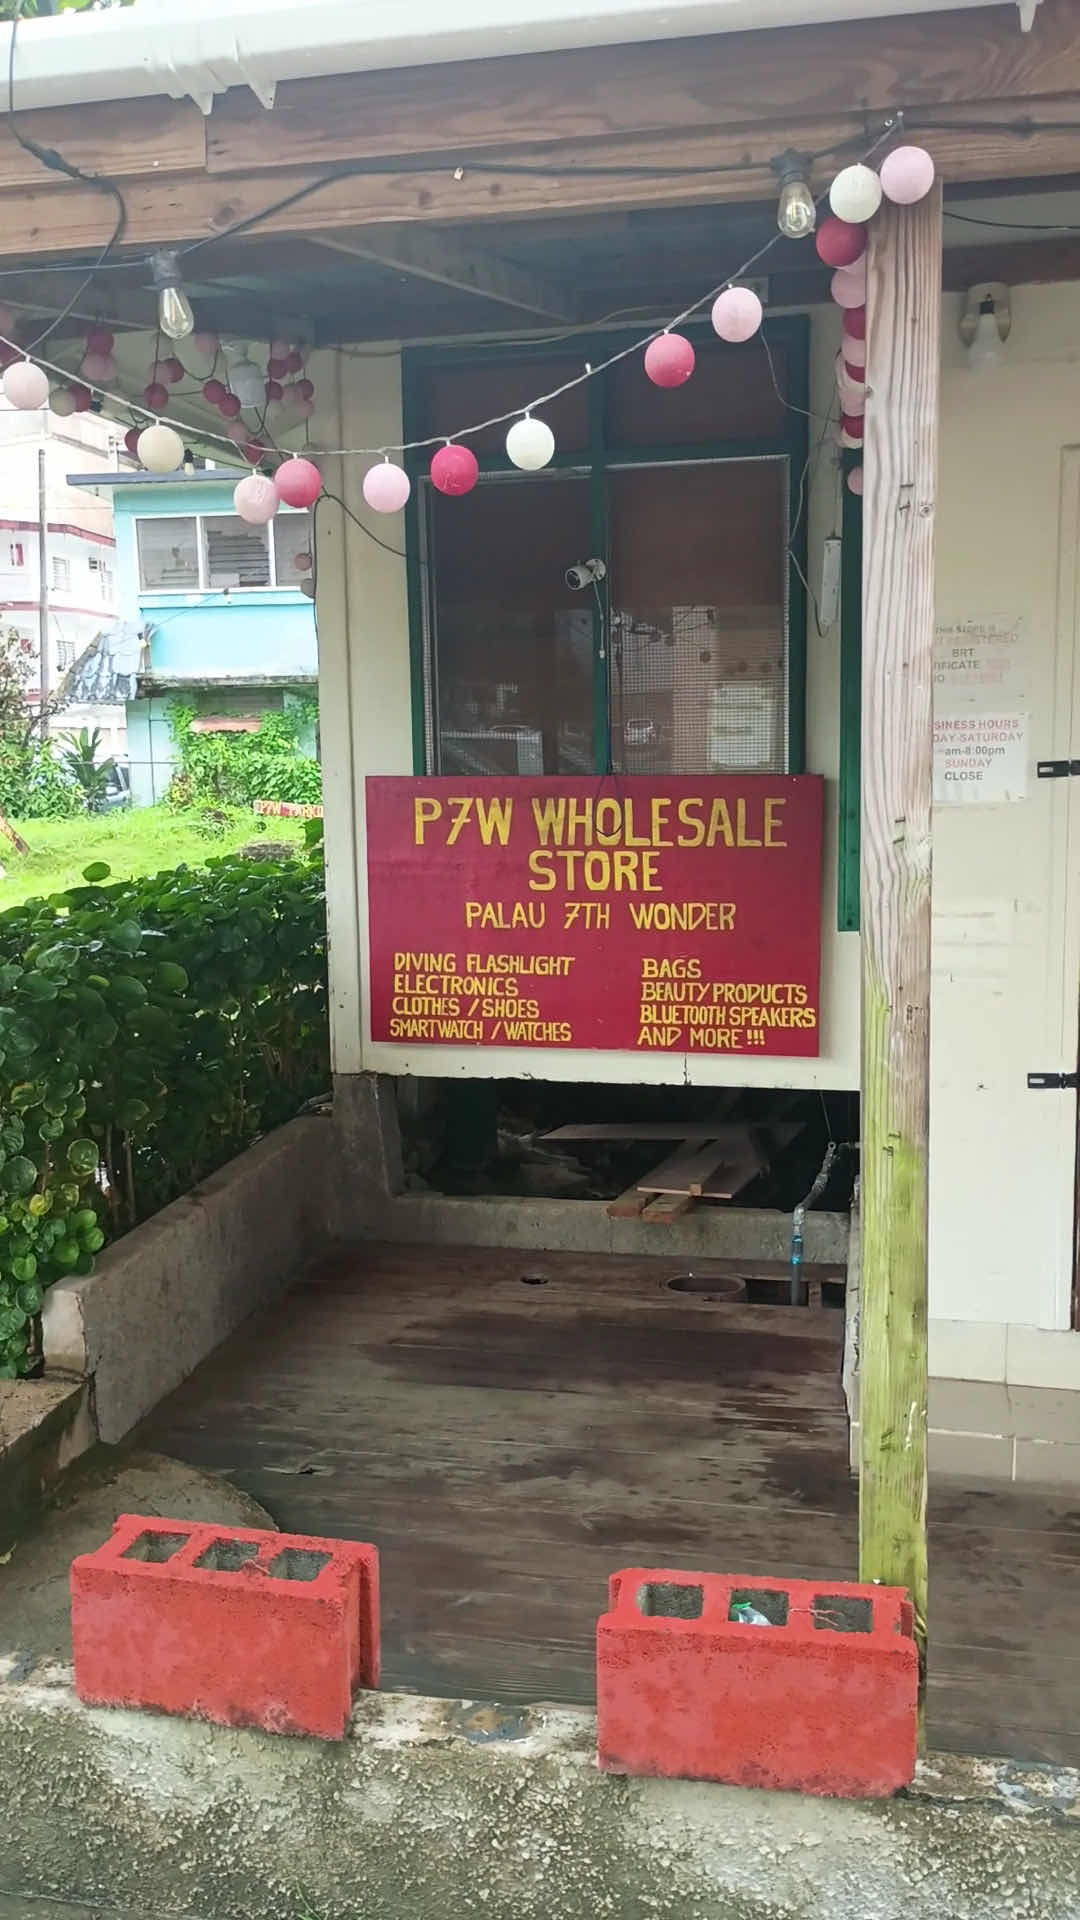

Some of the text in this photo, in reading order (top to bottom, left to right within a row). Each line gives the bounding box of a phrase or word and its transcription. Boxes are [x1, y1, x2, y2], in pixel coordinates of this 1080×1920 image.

[934, 719, 1019, 730] SINESS HOURS
[933, 732, 1024, 743] DAY-SATURDAY
[944, 770, 983, 781] CLOSE
[945, 759, 992, 769] SUNDAY
[414, 797, 788, 847] P7W WHOLESALE
[528, 851, 663, 892] STORE
[465, 901, 734, 930] PALAU 7TH WONDER
[393, 952, 575, 976] DIVING FLASHLIGHT
[641, 957, 702, 979] BAGS
[393, 974, 519, 997] ELECTRONICS
[641, 981, 806, 1005] BEAUTY PRODUCTS
[392, 997, 460, 1017] CLOTHES
[639, 1004, 817, 1028] BLUETOOTH SPEAKERS
[390, 1018, 484, 1040] SMARTWATCH
[636, 1025, 682, 1046] AND
[689, 1028, 744, 1049] MORE
